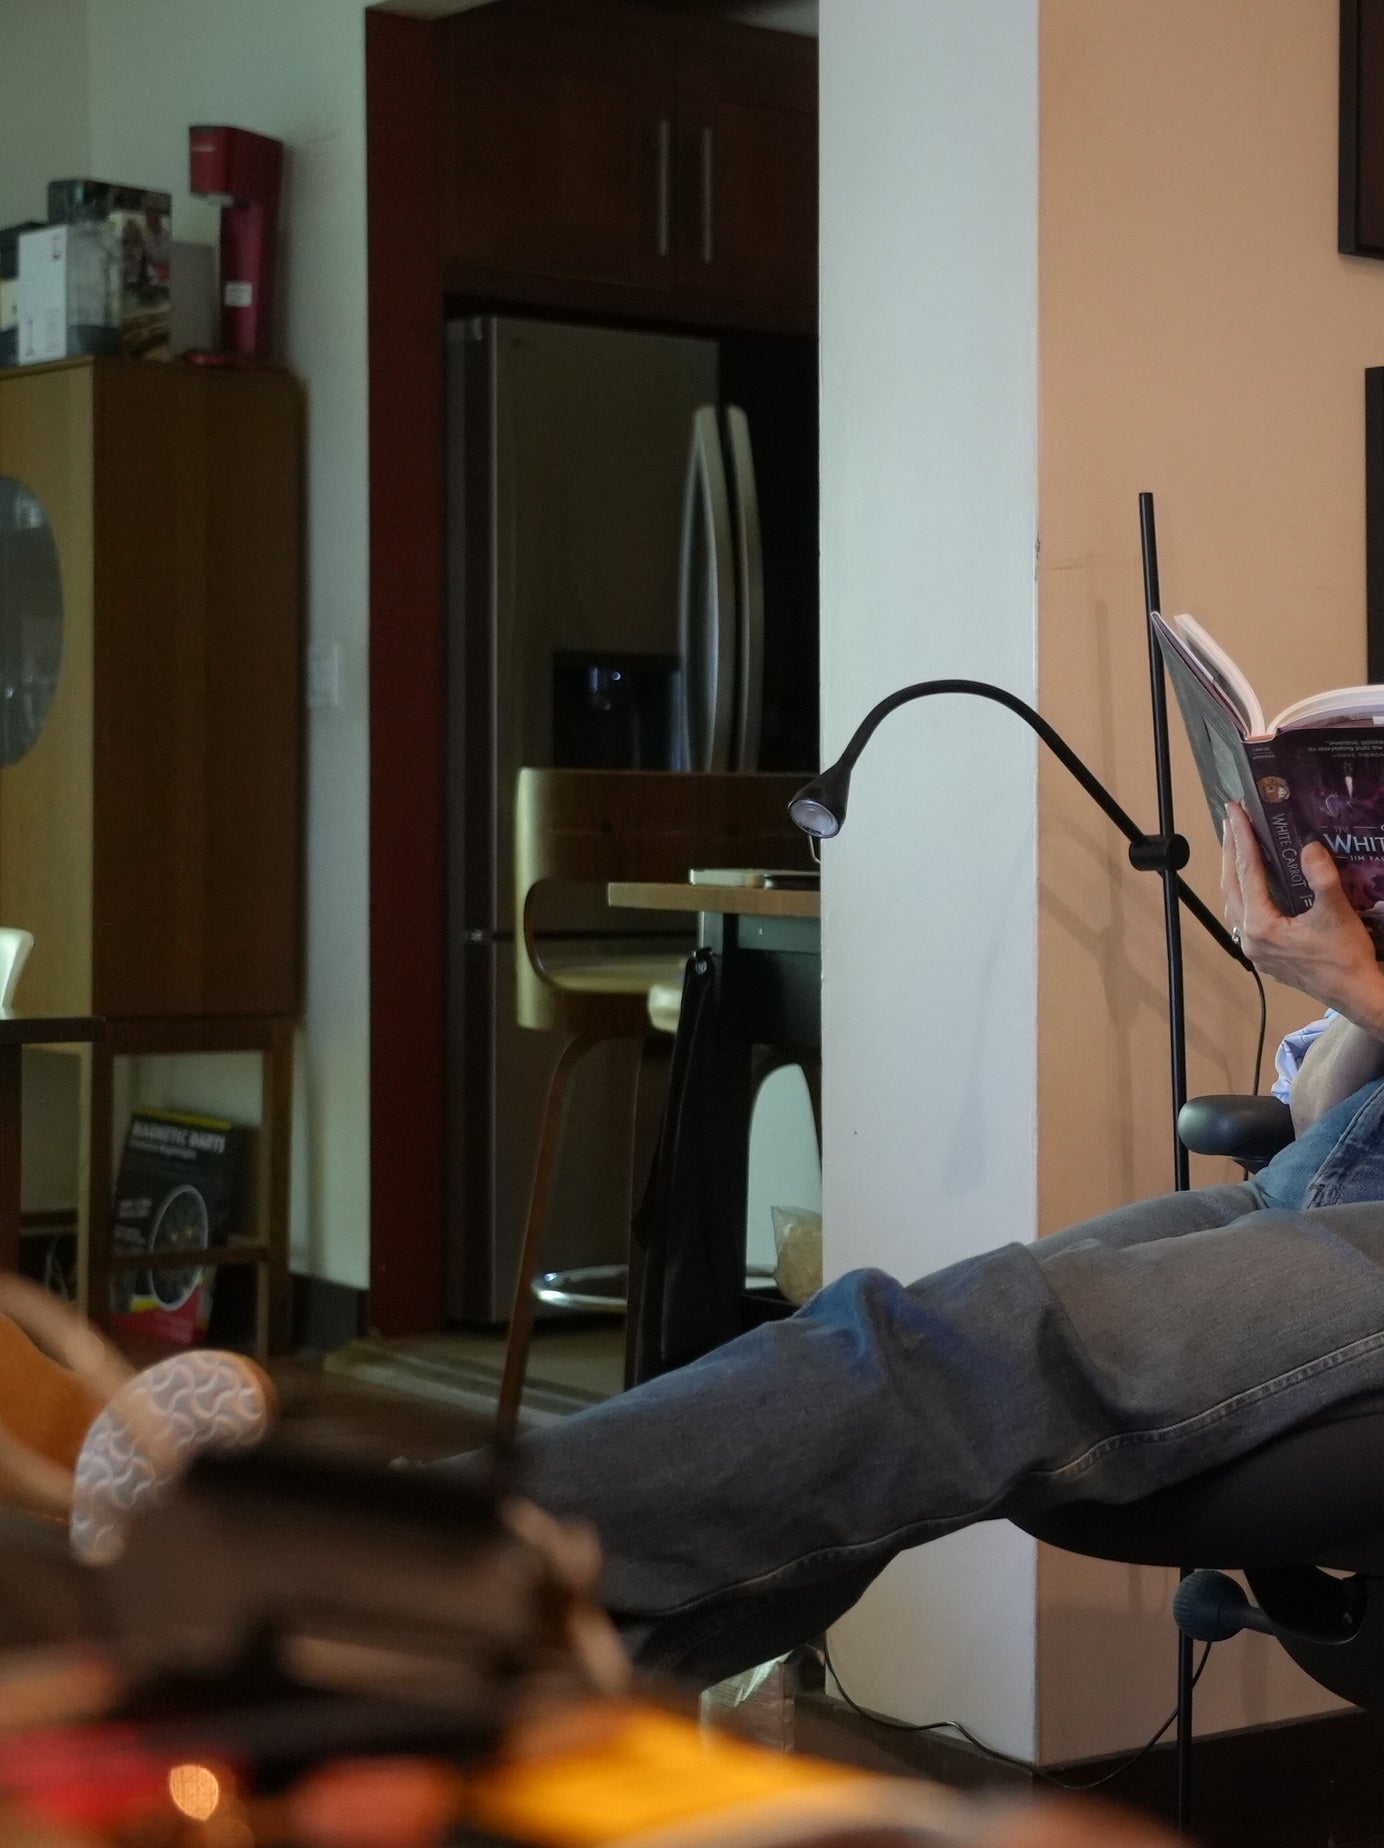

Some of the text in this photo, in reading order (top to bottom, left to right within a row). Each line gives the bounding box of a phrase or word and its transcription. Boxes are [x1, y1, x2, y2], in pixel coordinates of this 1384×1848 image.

[1270, 813, 1307, 888] WHITE CARROT
[1350, 855, 1366, 863] JIM
